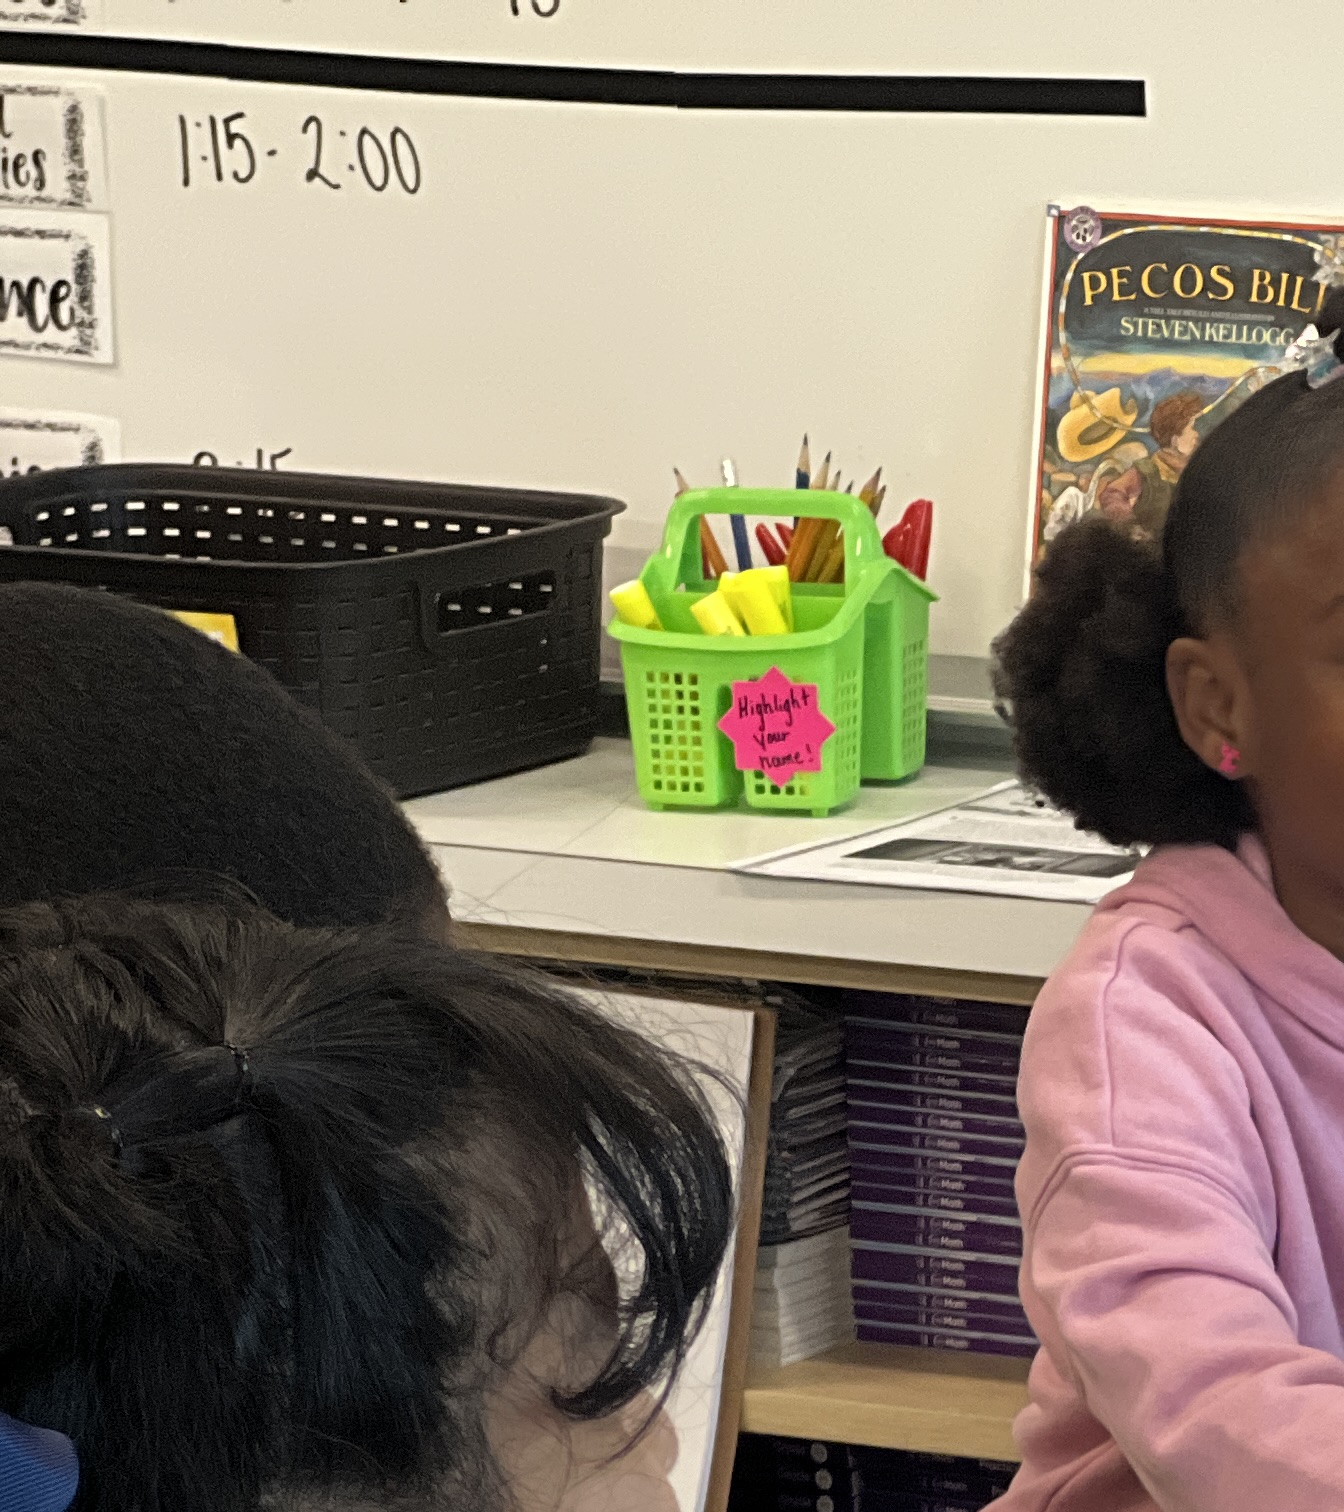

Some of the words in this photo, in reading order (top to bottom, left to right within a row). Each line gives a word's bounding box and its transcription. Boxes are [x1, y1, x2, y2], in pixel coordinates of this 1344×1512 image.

[301, 114, 422, 195] 2:00
[1080, 262, 1235, 306] PECOS
[1118, 315, 1202, 341] STEVEN
[1204, 321, 1294, 347] KELLOGG
[737, 687, 810, 732] Highlight
